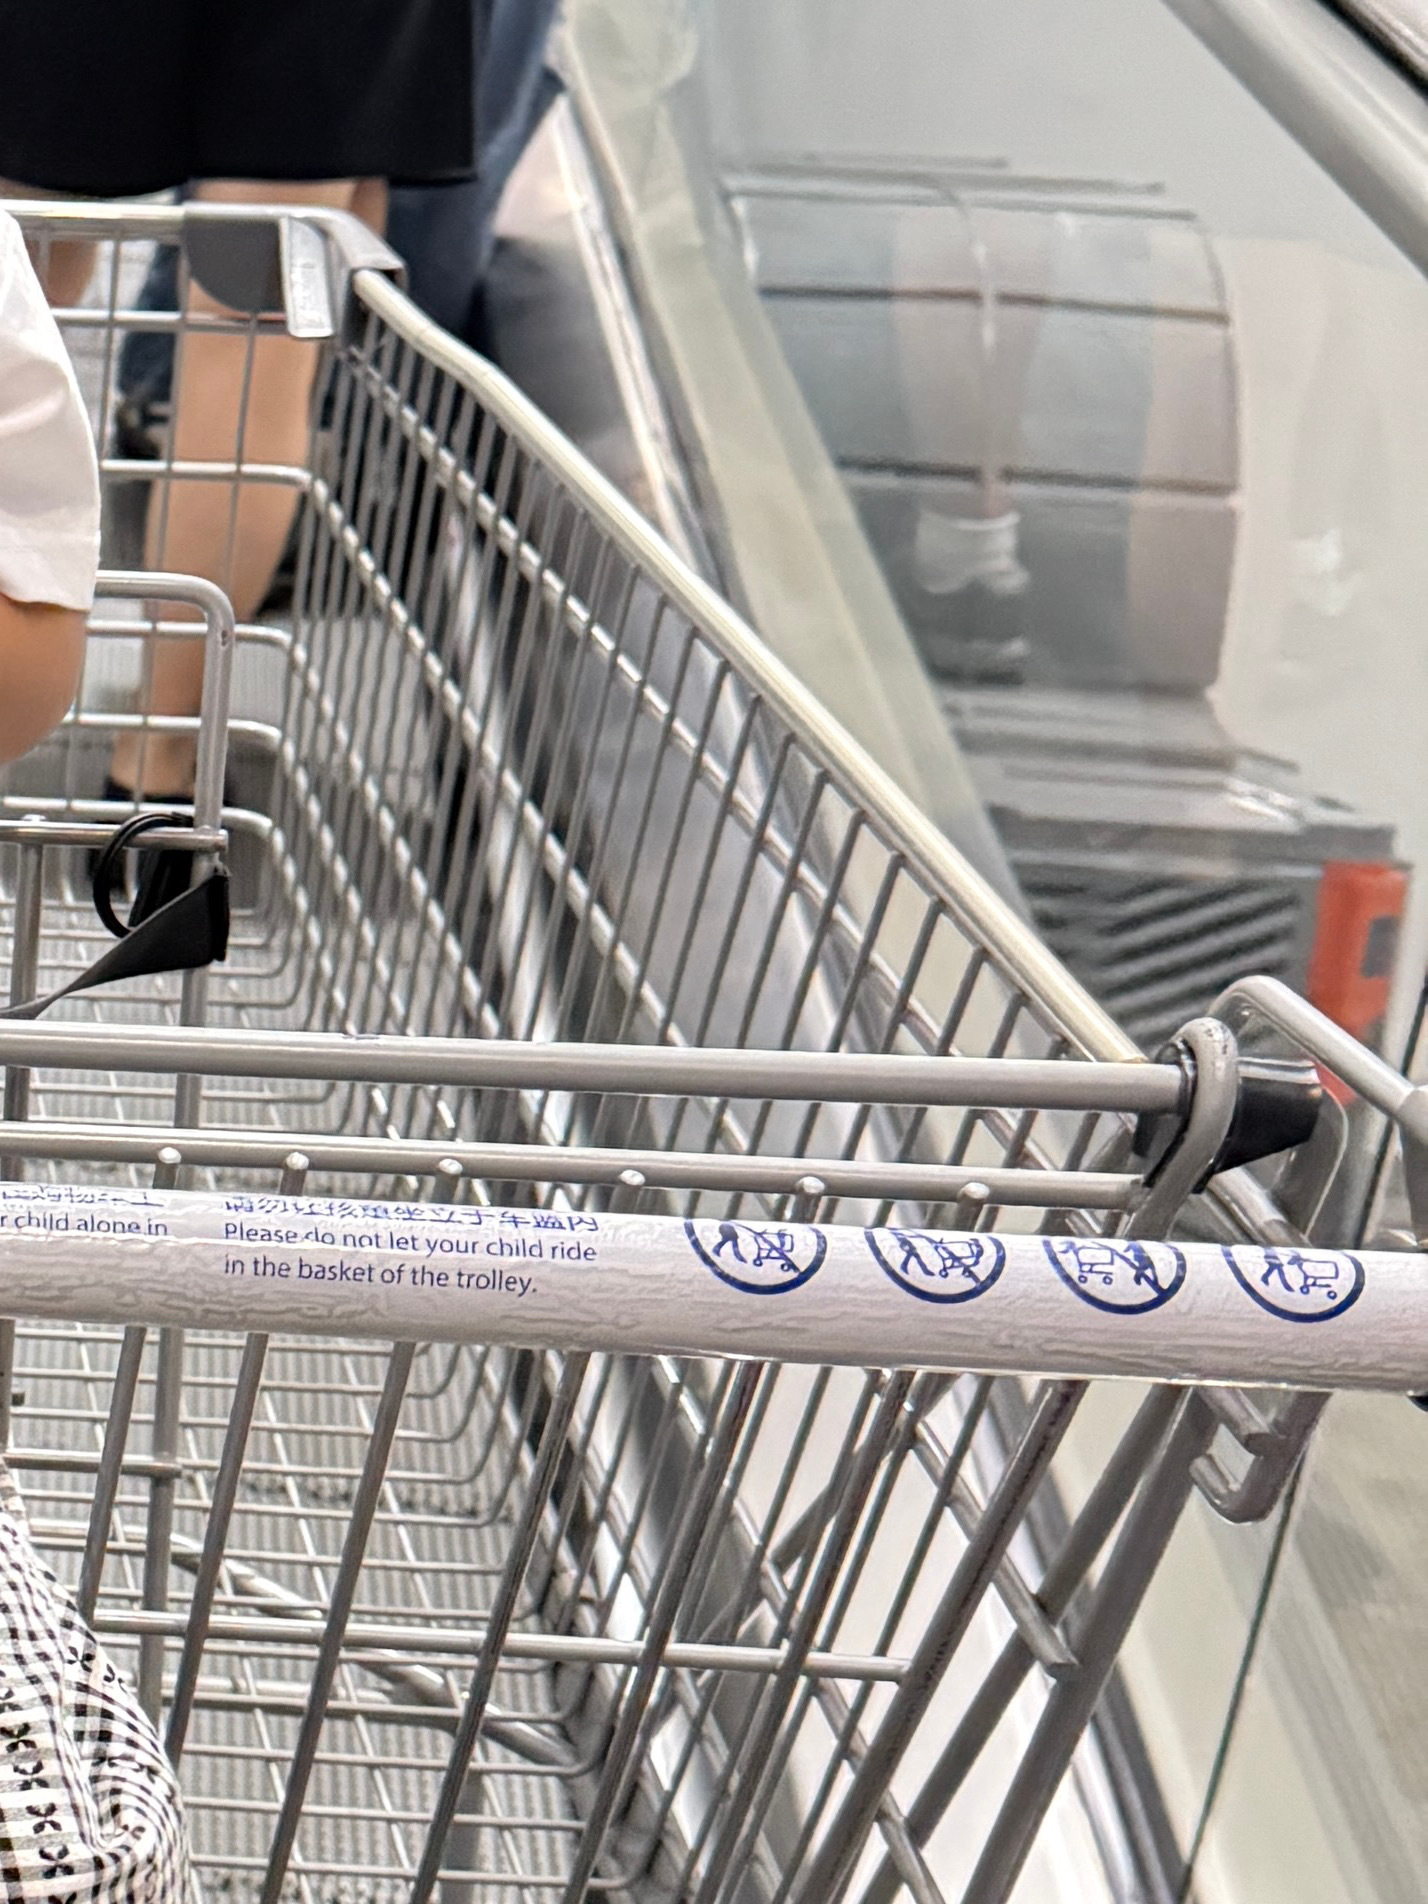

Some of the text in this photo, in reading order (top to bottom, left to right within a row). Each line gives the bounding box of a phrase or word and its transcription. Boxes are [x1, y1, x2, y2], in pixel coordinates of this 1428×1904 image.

[15, 1211, 69, 1232] child
[77, 1215, 141, 1235] alone
[147, 1218, 168, 1237] in
[224, 1222, 597, 1262] Please do not let your child ride
[224, 1255, 538, 1297] in the basket of the trolley.
